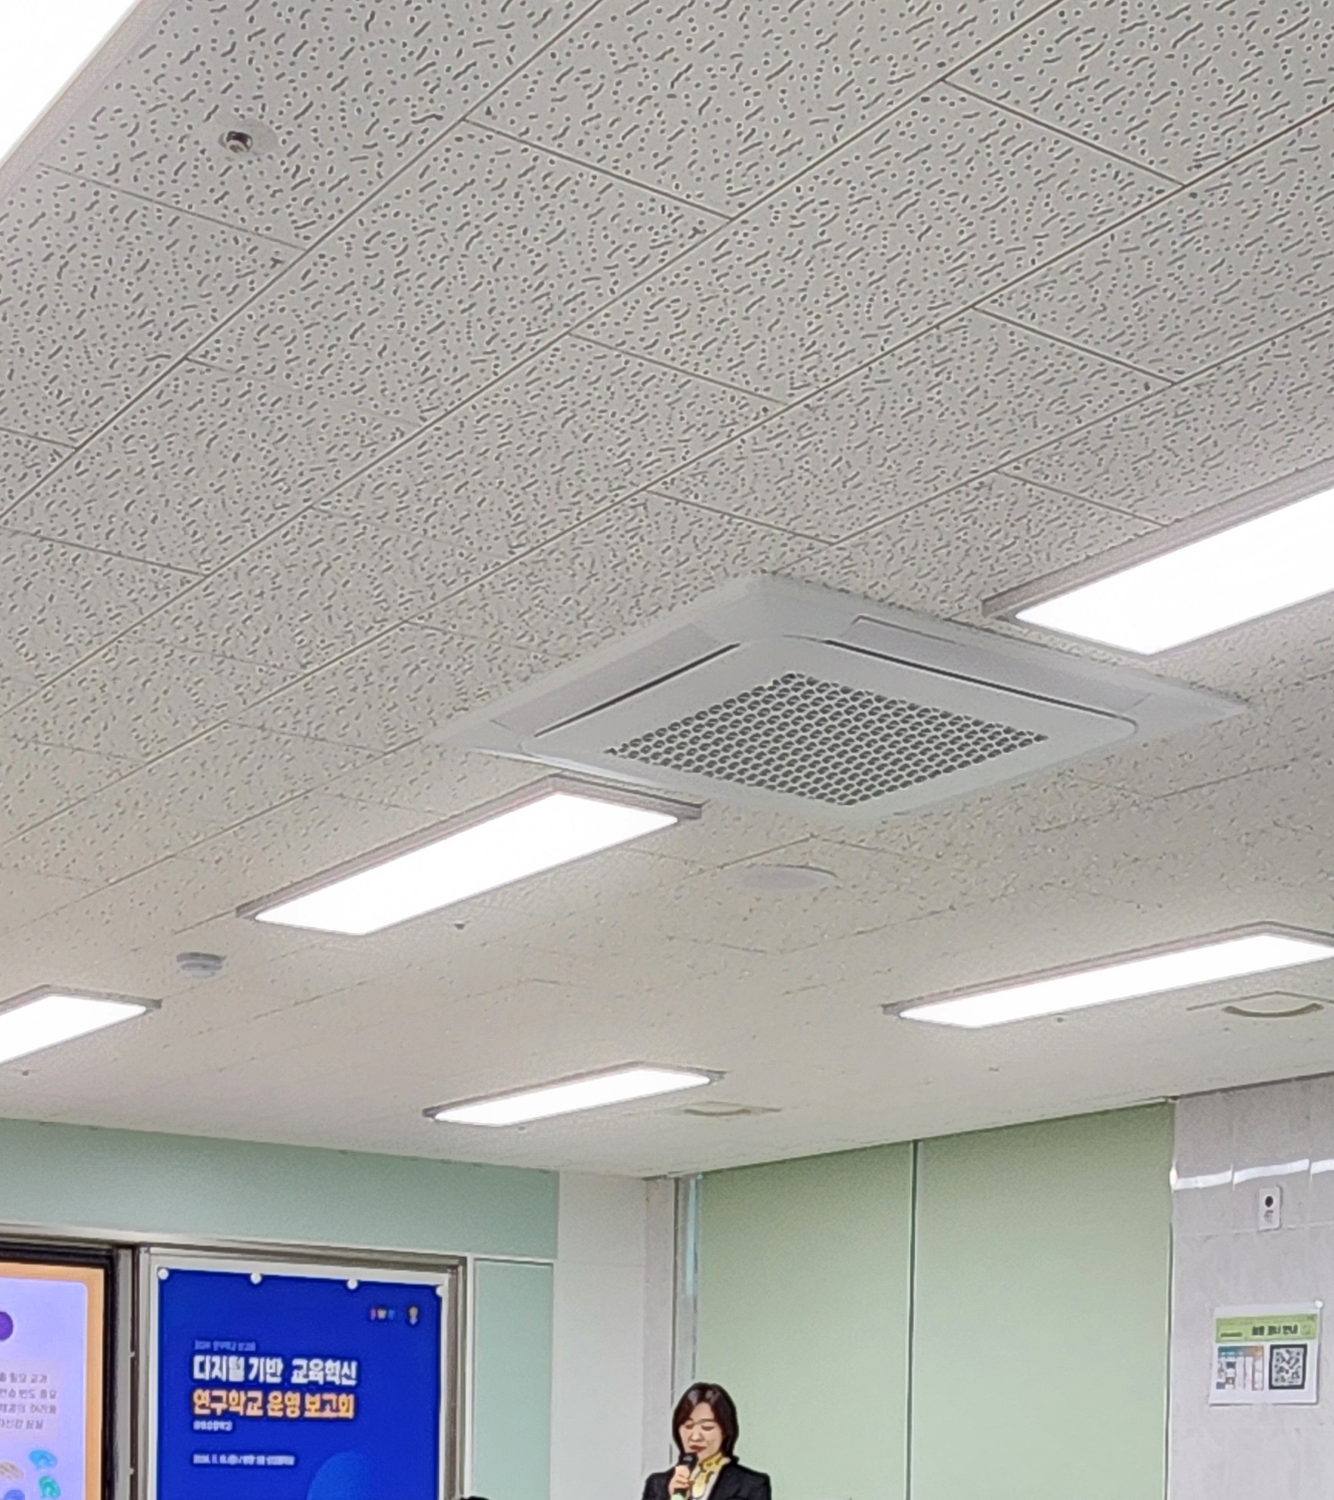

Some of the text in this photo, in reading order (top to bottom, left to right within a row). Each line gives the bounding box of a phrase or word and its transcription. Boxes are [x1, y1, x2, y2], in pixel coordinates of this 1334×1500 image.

[192, 1354, 358, 1386] 디지털 기반 교육혁신
[192, 1388, 355, 1419] 연구학교 운영 보고회
